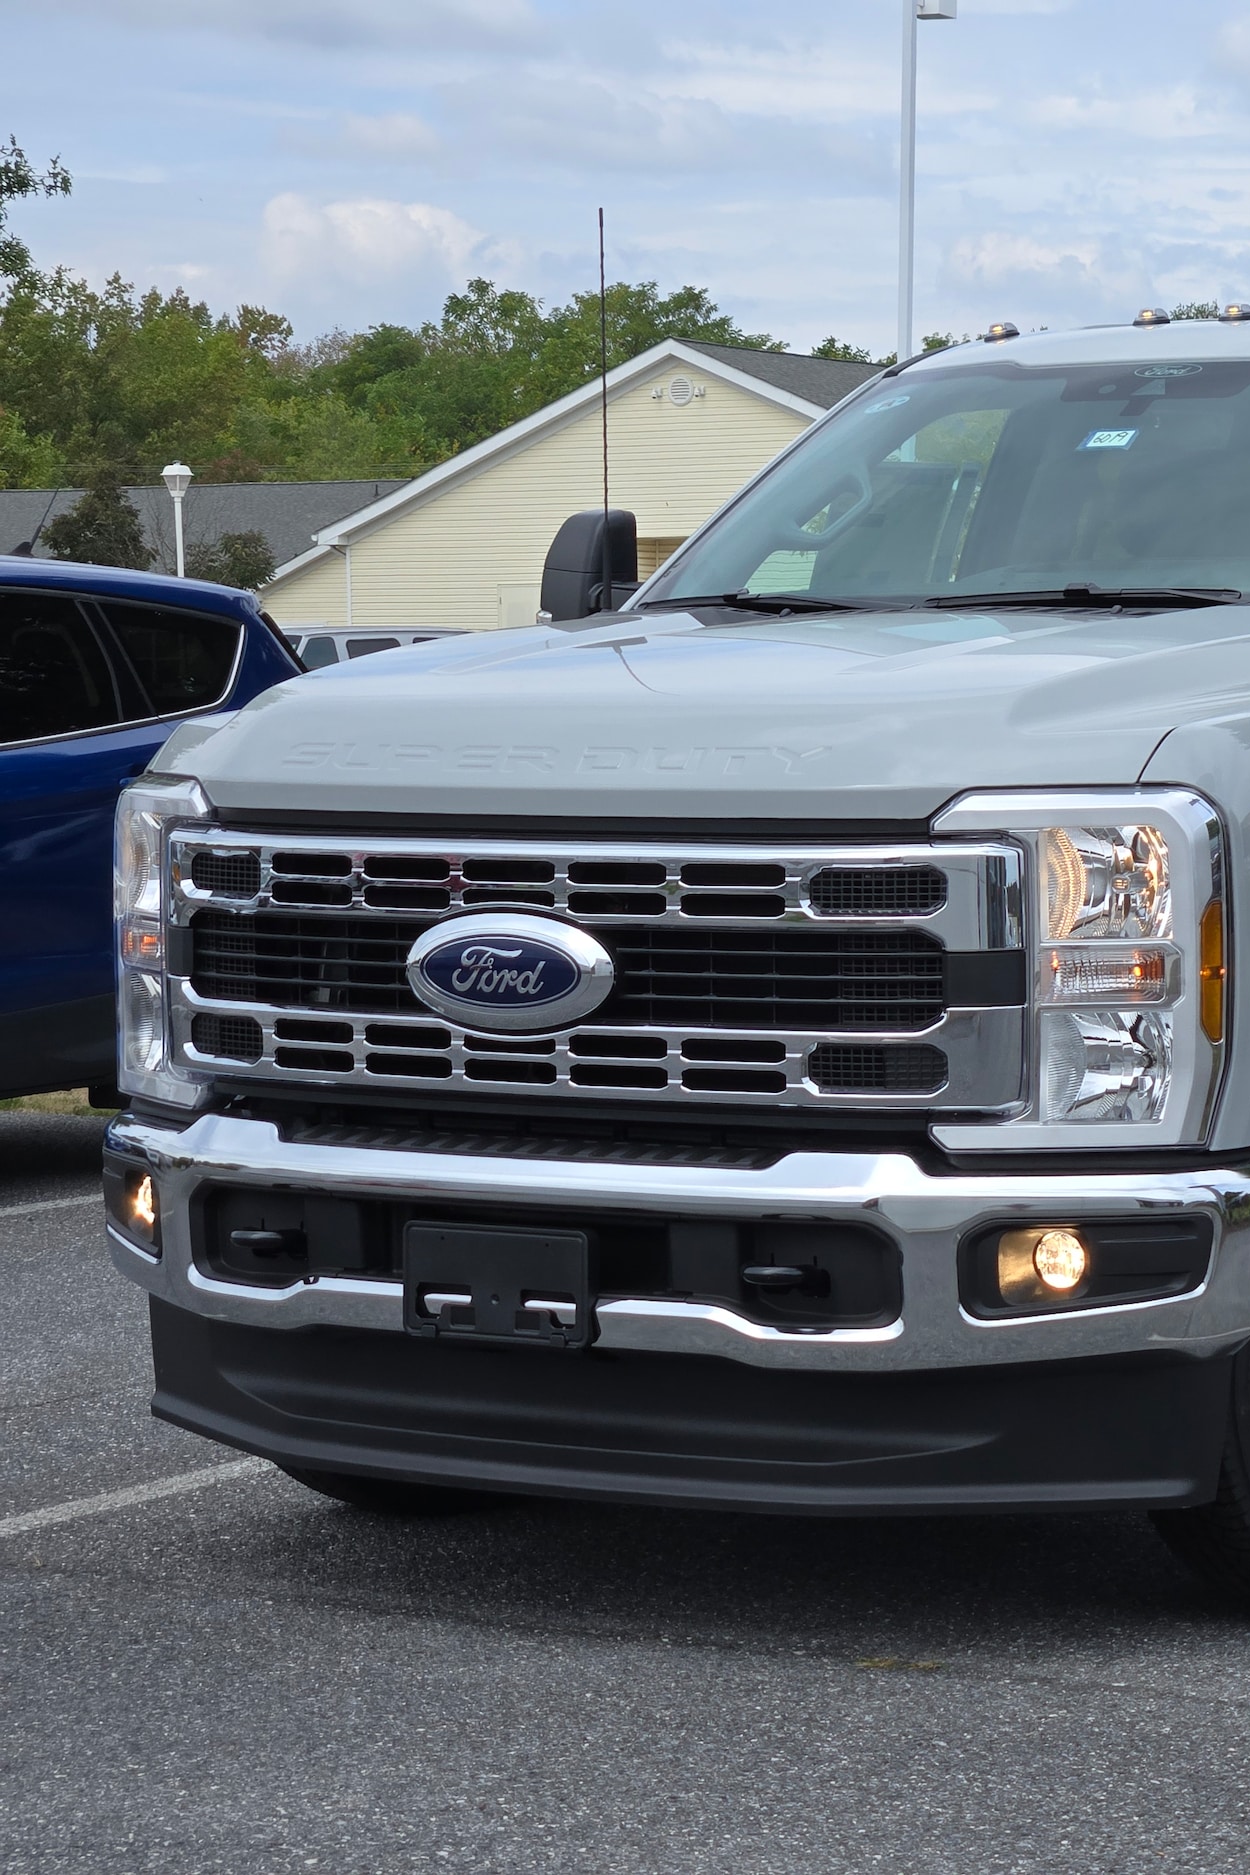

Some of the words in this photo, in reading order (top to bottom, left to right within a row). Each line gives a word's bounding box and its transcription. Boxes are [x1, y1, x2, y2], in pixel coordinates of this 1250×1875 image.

[281, 741, 561, 774] SUPER
[574, 744, 833, 776] DUTY
[451, 945, 547, 995] Ford
